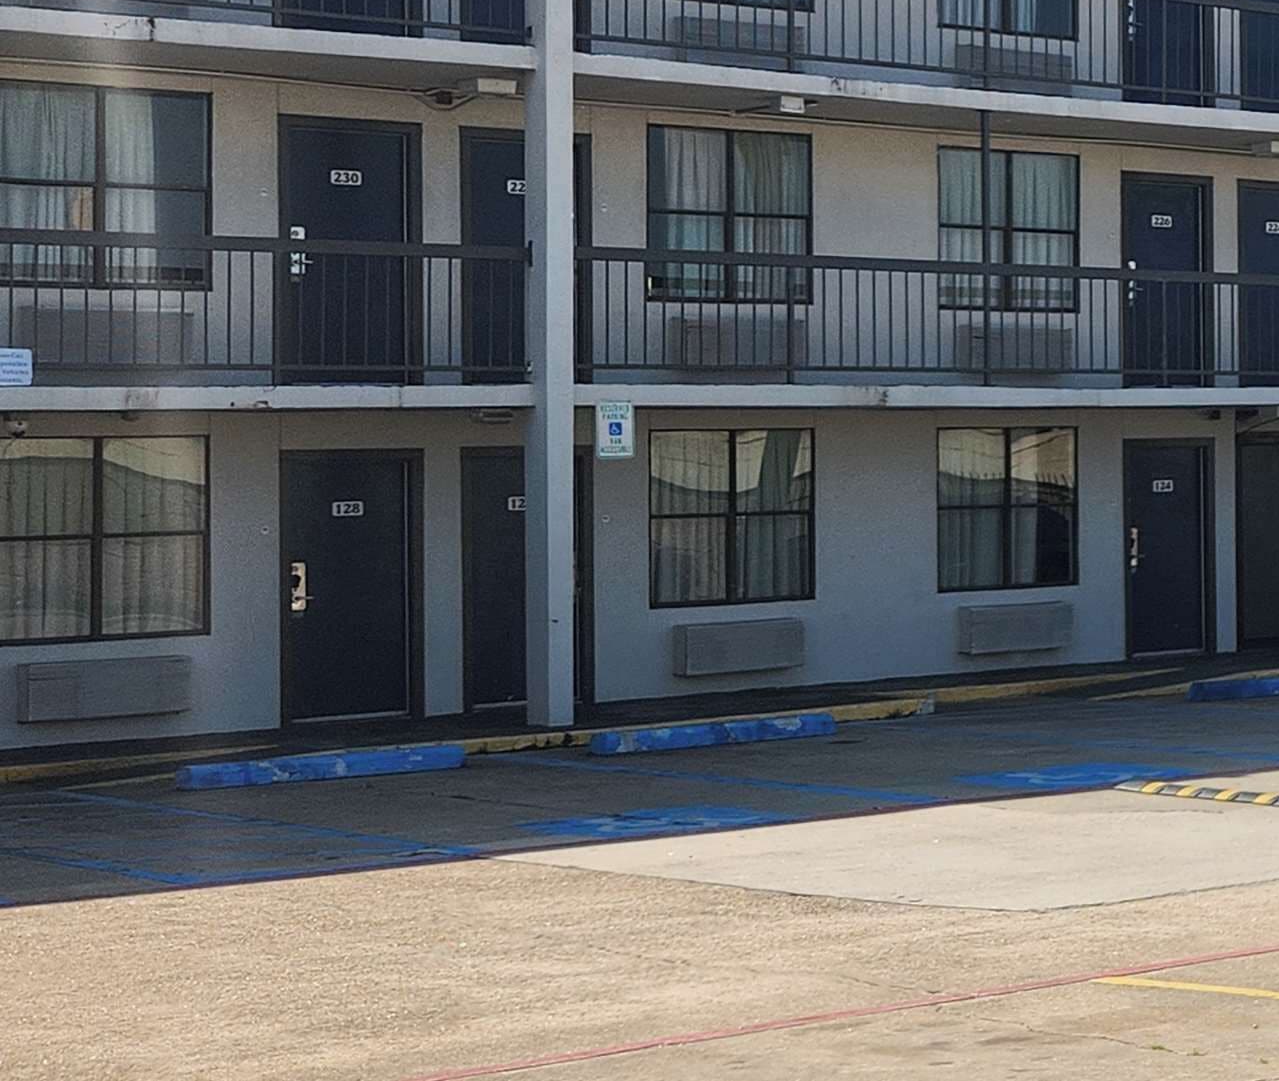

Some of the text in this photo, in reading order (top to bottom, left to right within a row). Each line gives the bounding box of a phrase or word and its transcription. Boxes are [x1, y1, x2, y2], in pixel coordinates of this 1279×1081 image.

[333, 172, 359, 184] 230
[510, 181, 527, 193] 22
[335, 503, 361, 514] 128
[511, 498, 527, 509] 12
